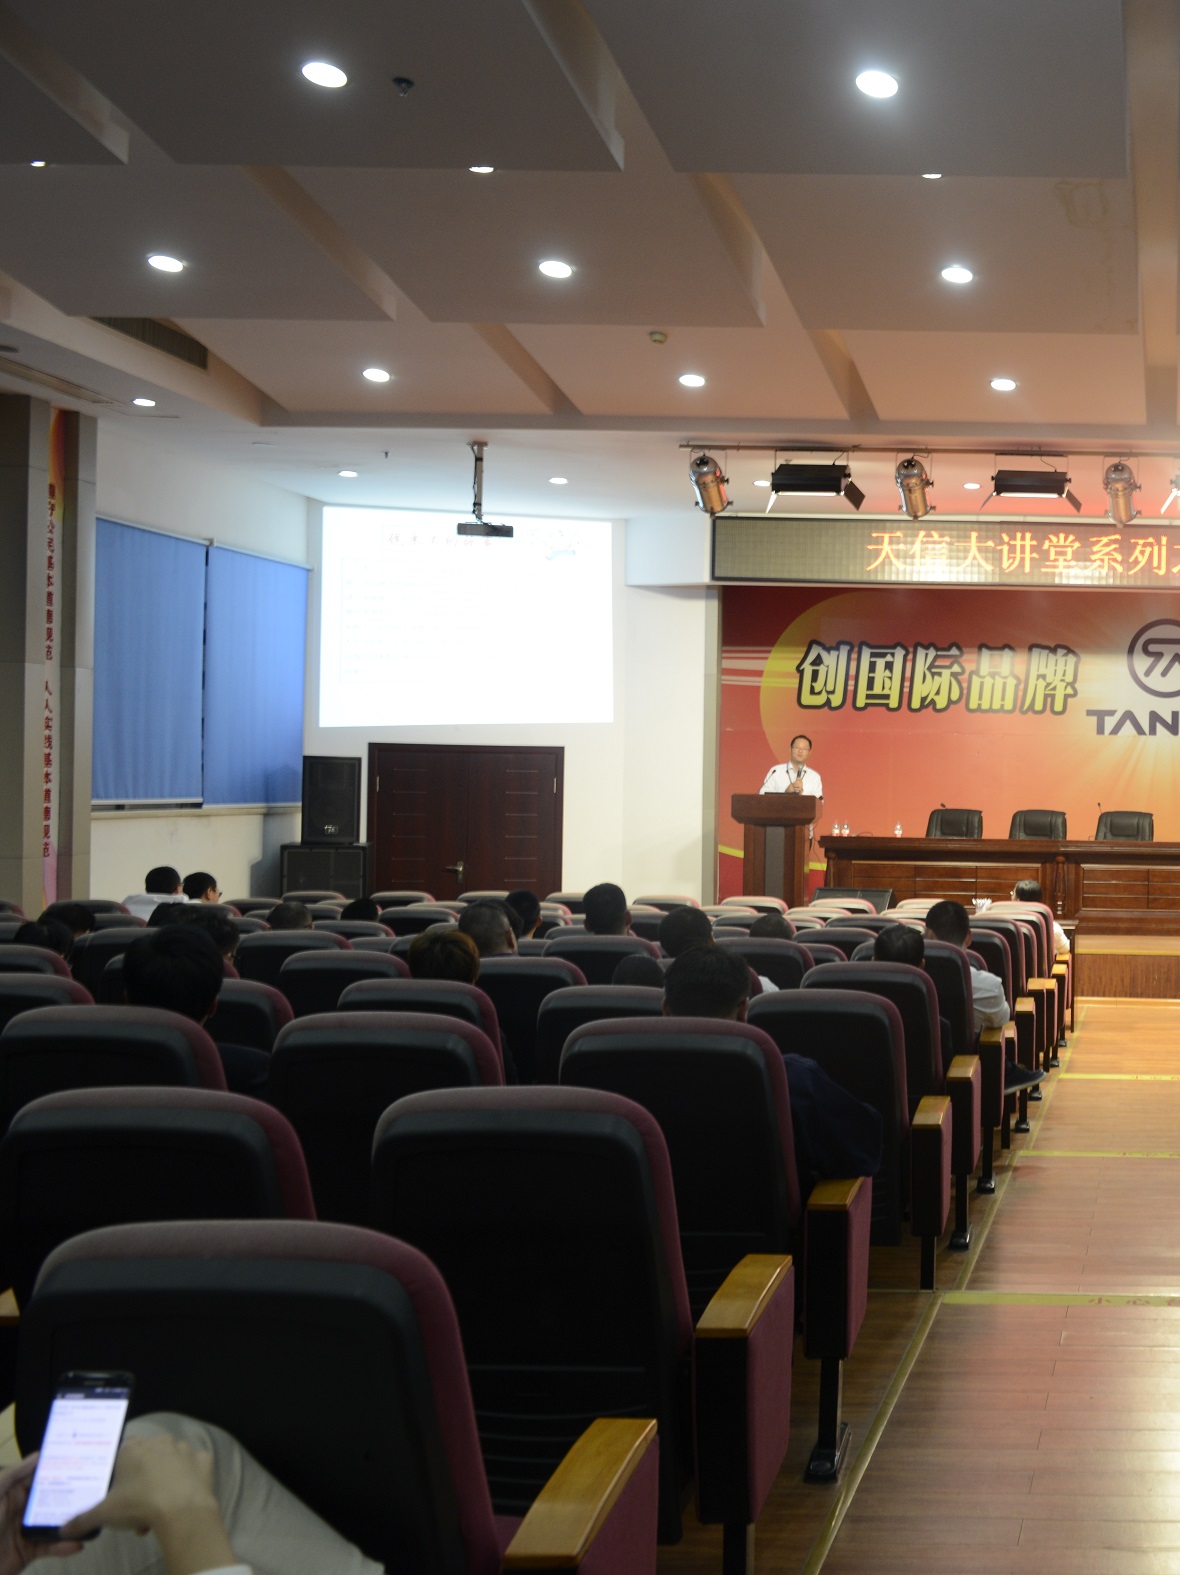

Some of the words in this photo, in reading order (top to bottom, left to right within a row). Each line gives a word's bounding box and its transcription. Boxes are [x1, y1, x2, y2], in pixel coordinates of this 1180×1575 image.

[797, 640, 1079, 714] 创国际品牌
